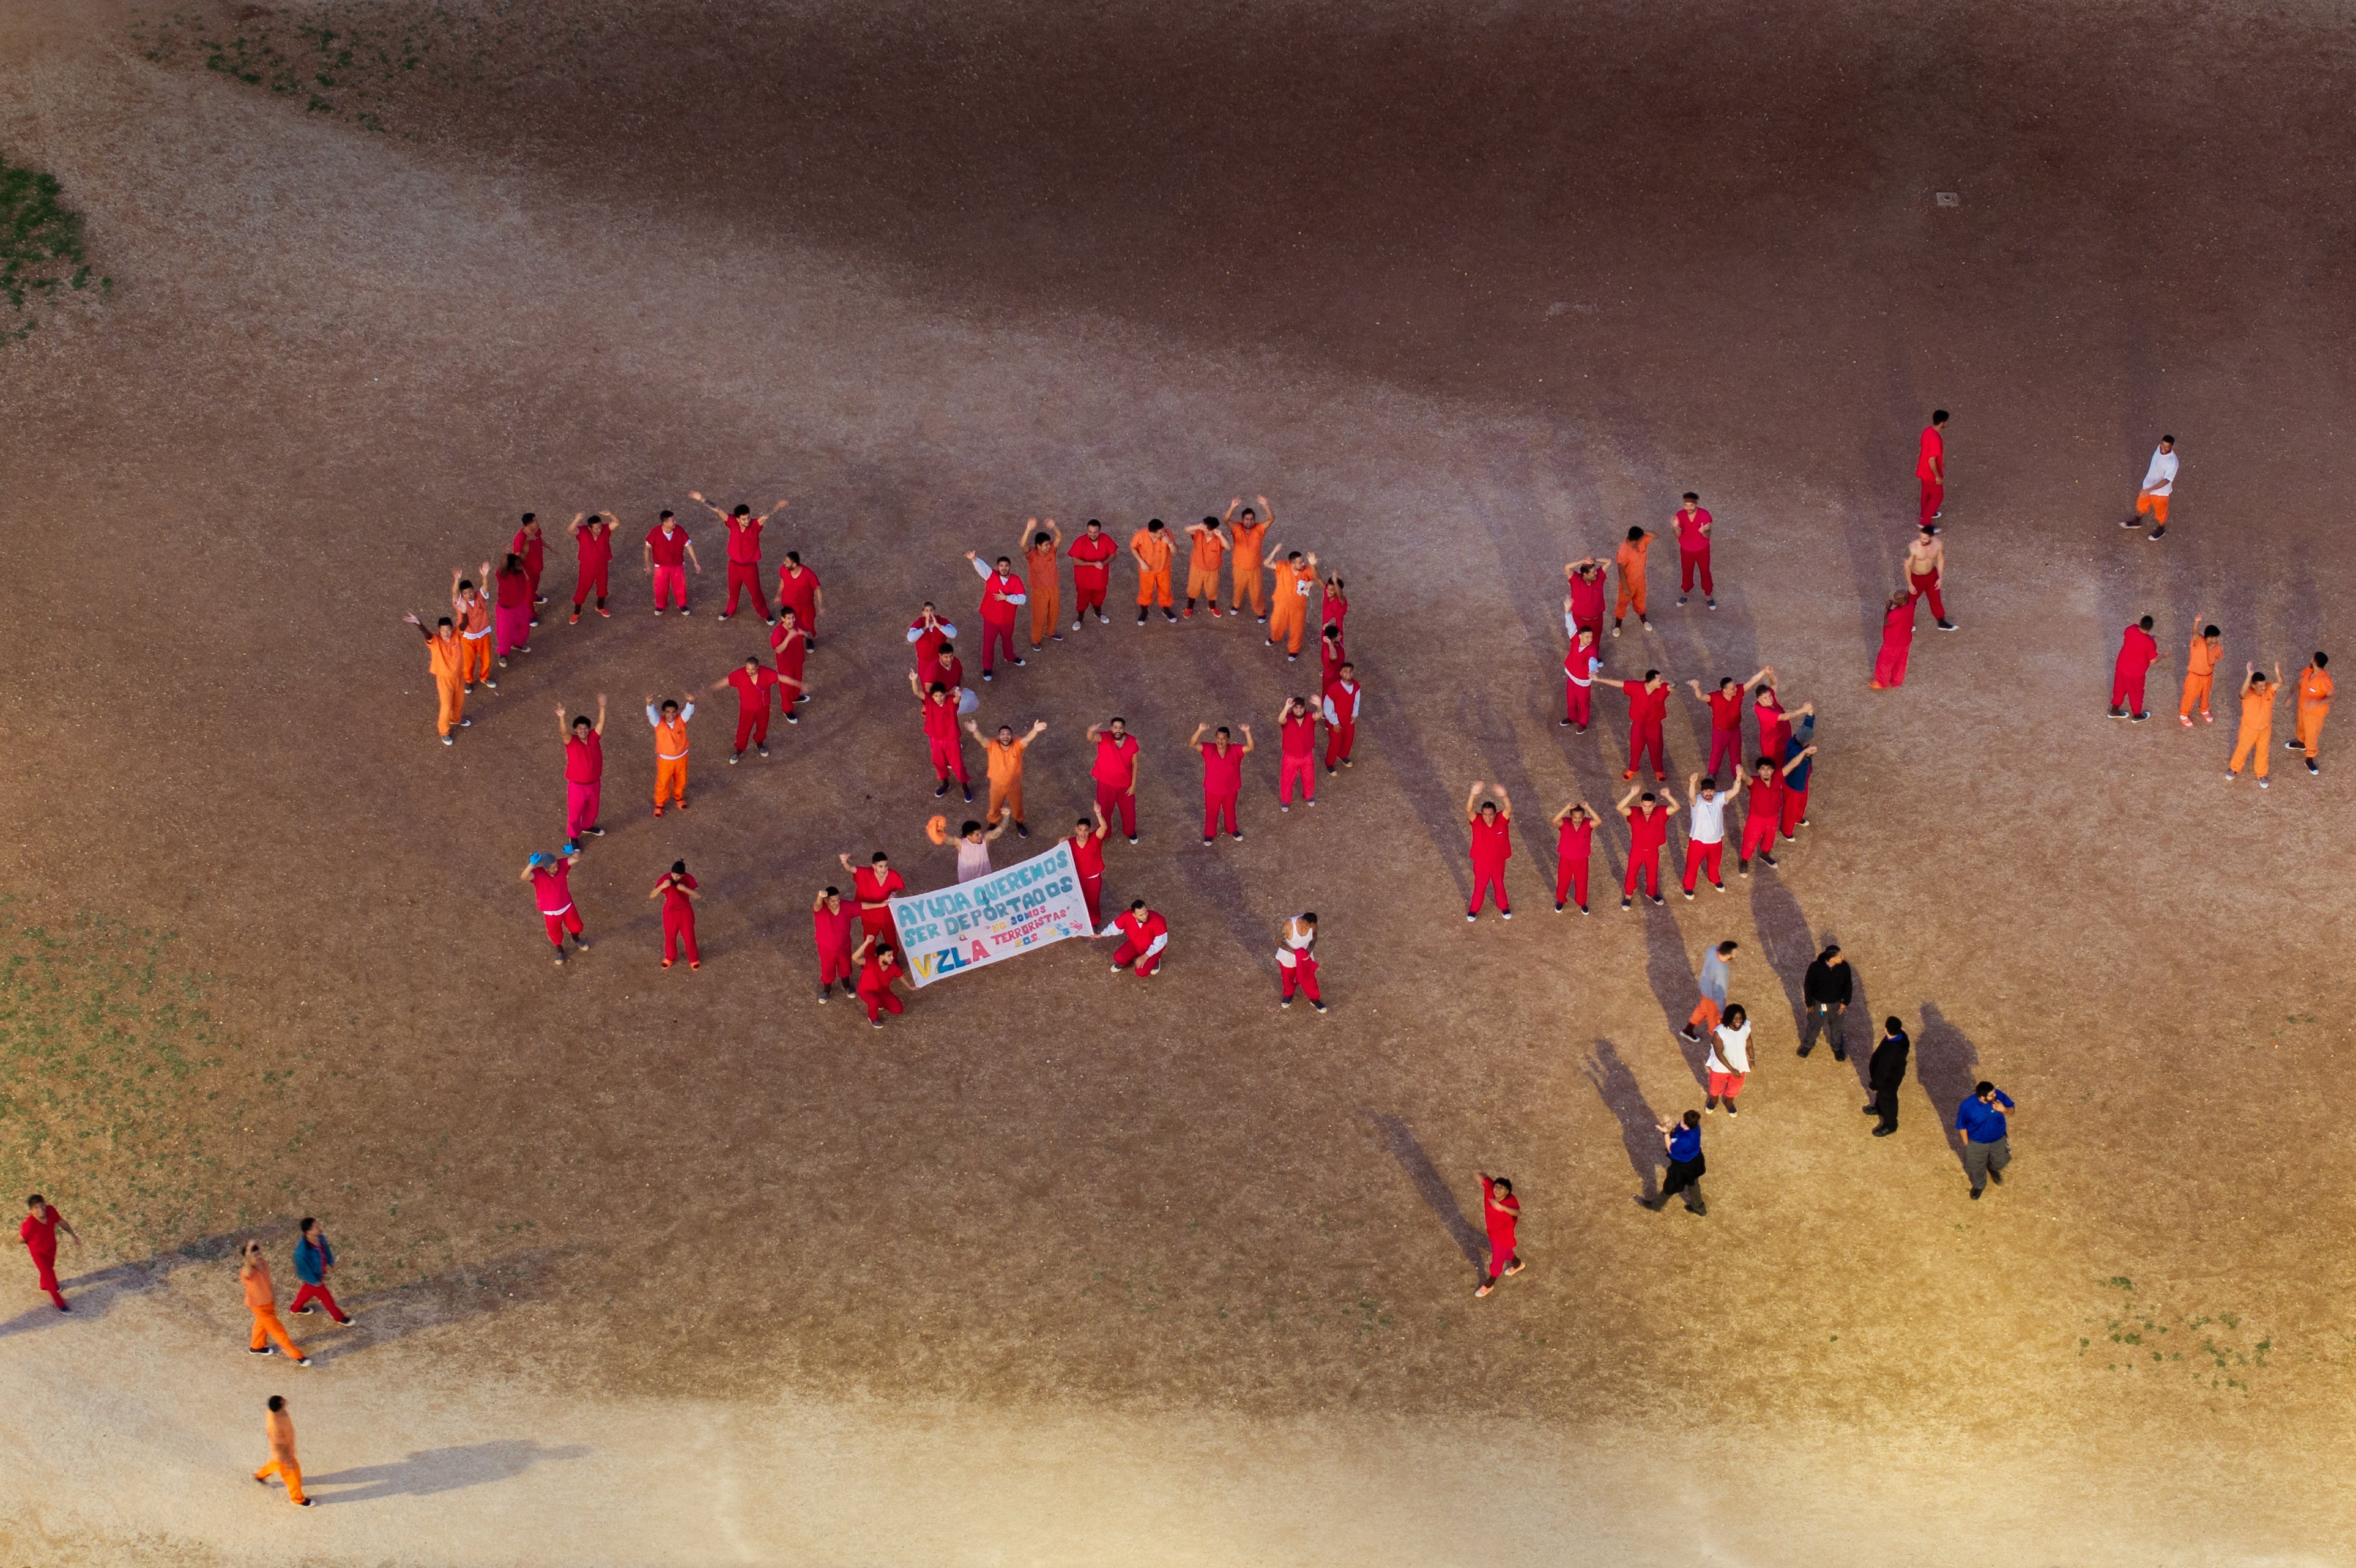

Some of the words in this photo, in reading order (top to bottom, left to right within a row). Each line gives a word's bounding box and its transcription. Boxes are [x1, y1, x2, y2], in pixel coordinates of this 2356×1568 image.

[897, 892, 972, 927] AYUDA
[973, 850, 1068, 907] QUEREMOS
[904, 923, 940, 947] SER
[944, 876, 1073, 935] DEPORTADOS
[1010, 905, 1046, 926] SOMOS
[912, 940, 991, 979] VZLA
